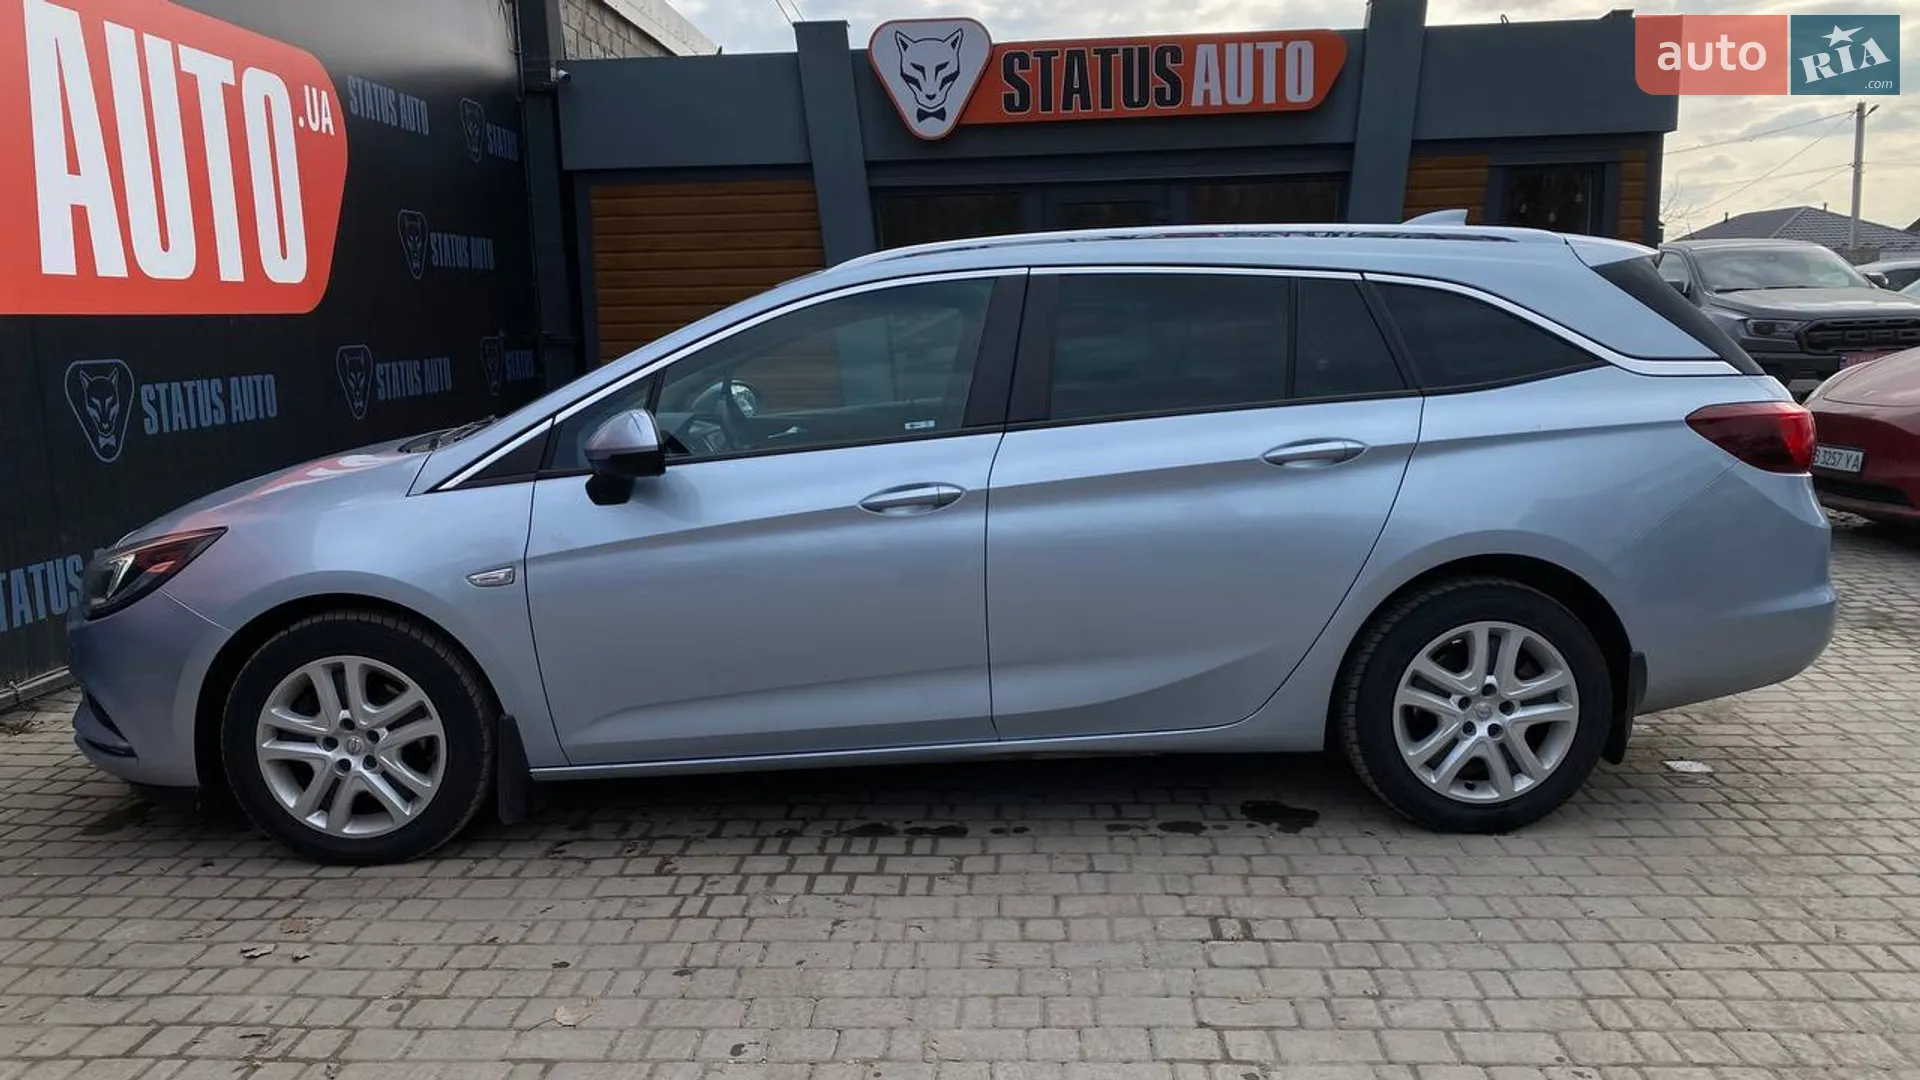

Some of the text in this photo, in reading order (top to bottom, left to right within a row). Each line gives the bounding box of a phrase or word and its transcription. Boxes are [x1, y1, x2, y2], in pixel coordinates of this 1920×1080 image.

[347, 75, 430, 135] STATUS AUTO
[1002, 40, 1314, 115] STATUS AUTO
[430, 232, 495, 270] STATUS AUTO
[140, 373, 278, 435] STATUS AUTO
[375, 357, 452, 400] STATUS AUTO
